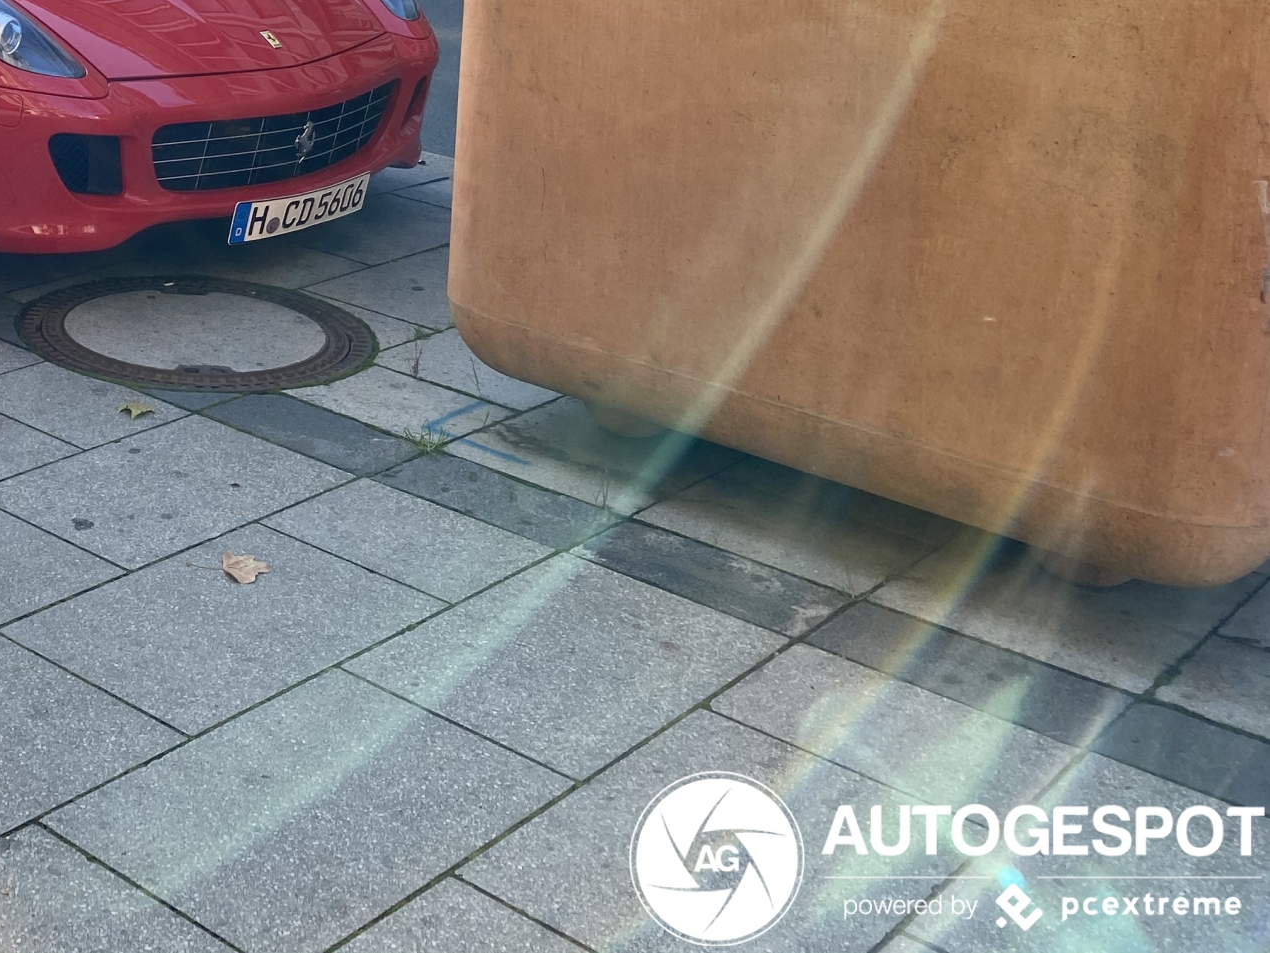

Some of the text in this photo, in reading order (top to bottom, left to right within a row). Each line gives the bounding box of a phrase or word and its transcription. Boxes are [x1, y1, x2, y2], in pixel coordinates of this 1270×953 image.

[247, 178, 365, 237] H CD 5606
[235, 227, 242, 237] D
